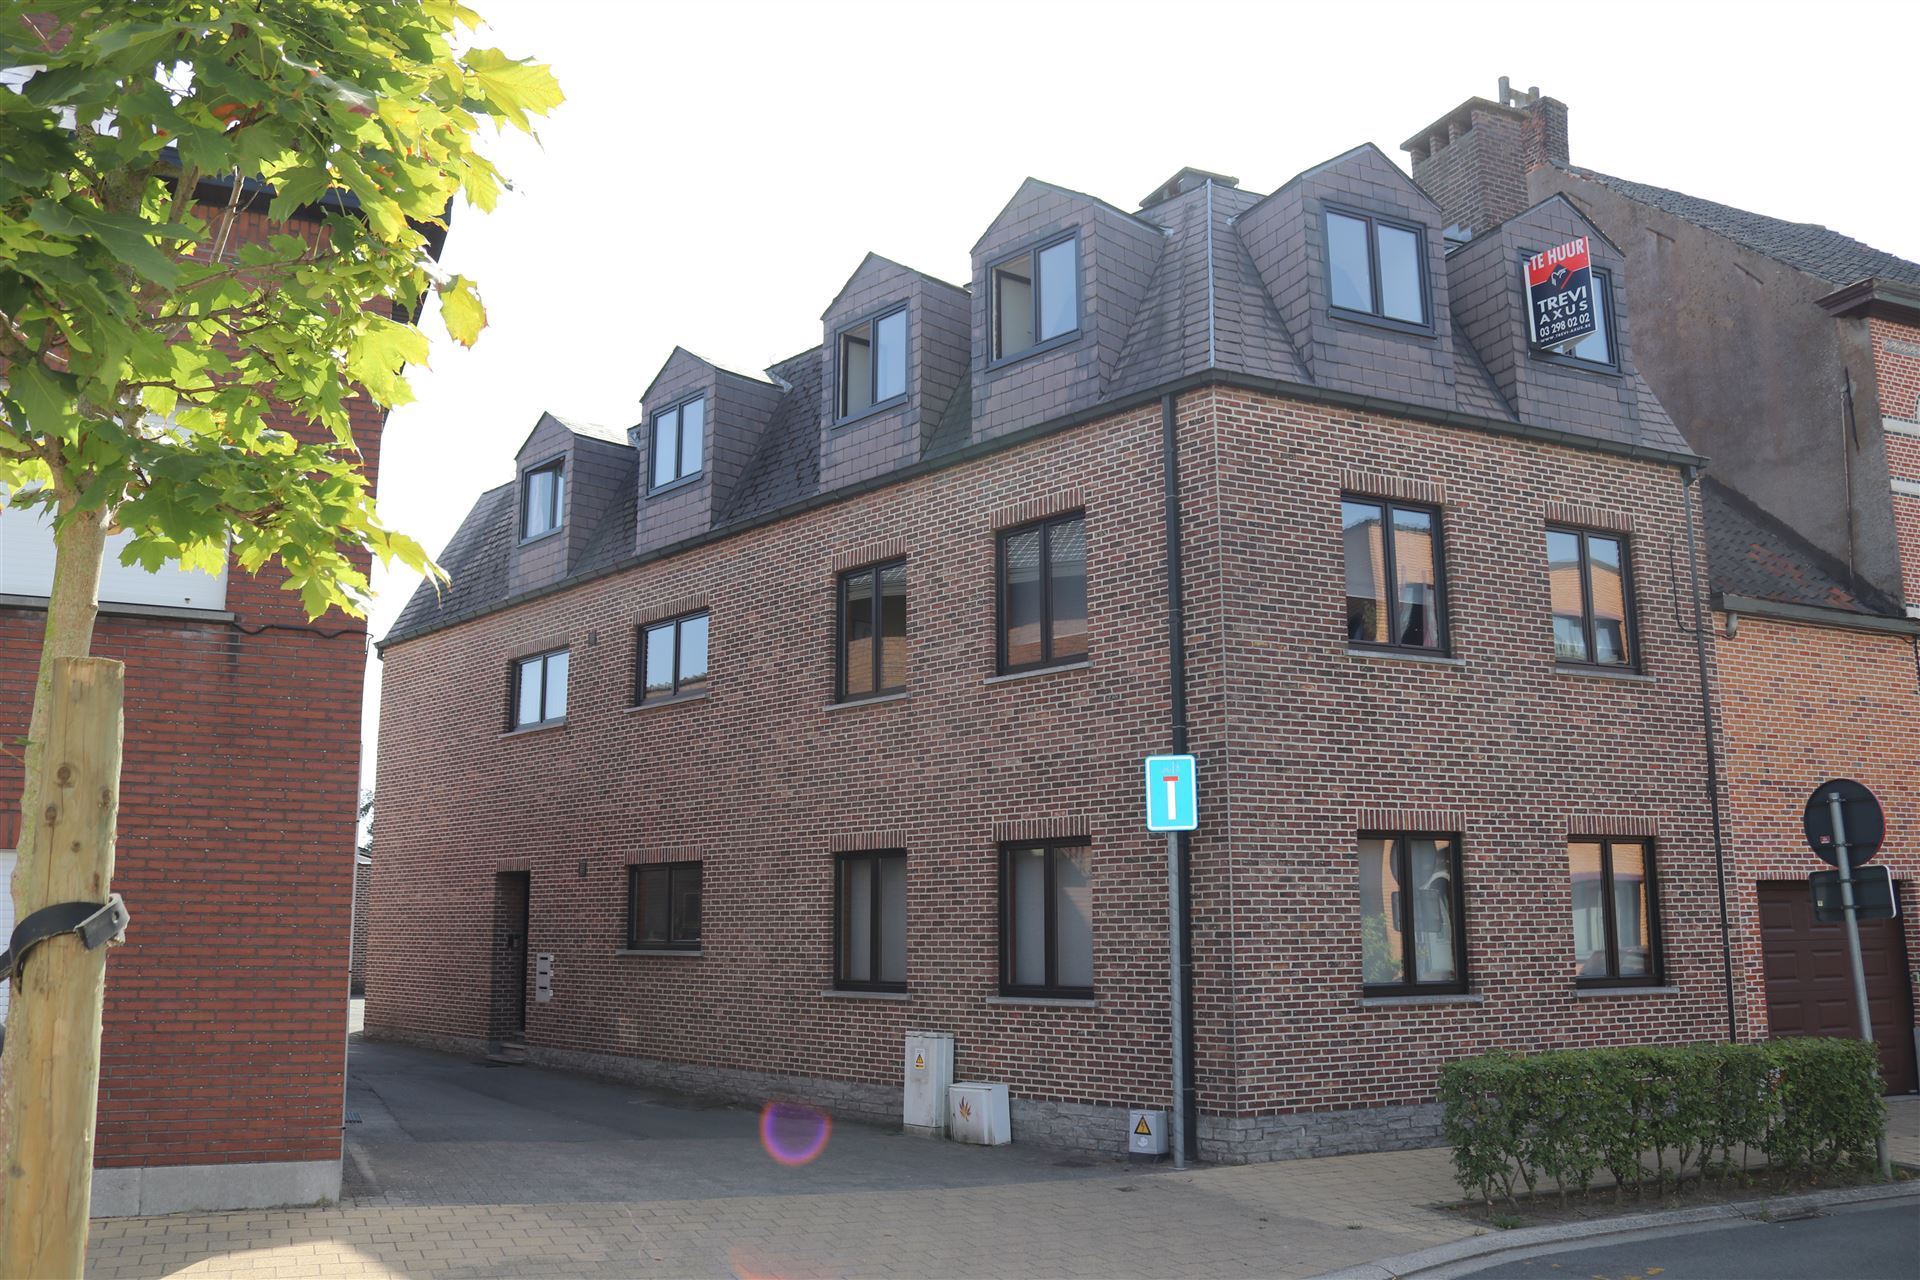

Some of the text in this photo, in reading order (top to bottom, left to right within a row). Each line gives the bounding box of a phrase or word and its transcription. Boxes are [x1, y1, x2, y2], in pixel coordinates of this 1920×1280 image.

[1530, 238, 1585, 271] TE HUUR
[1537, 285, 1587, 313] TREVI
[1540, 300, 1588, 325] AXUS
[1540, 312, 1590, 338] 03 298 02 02
